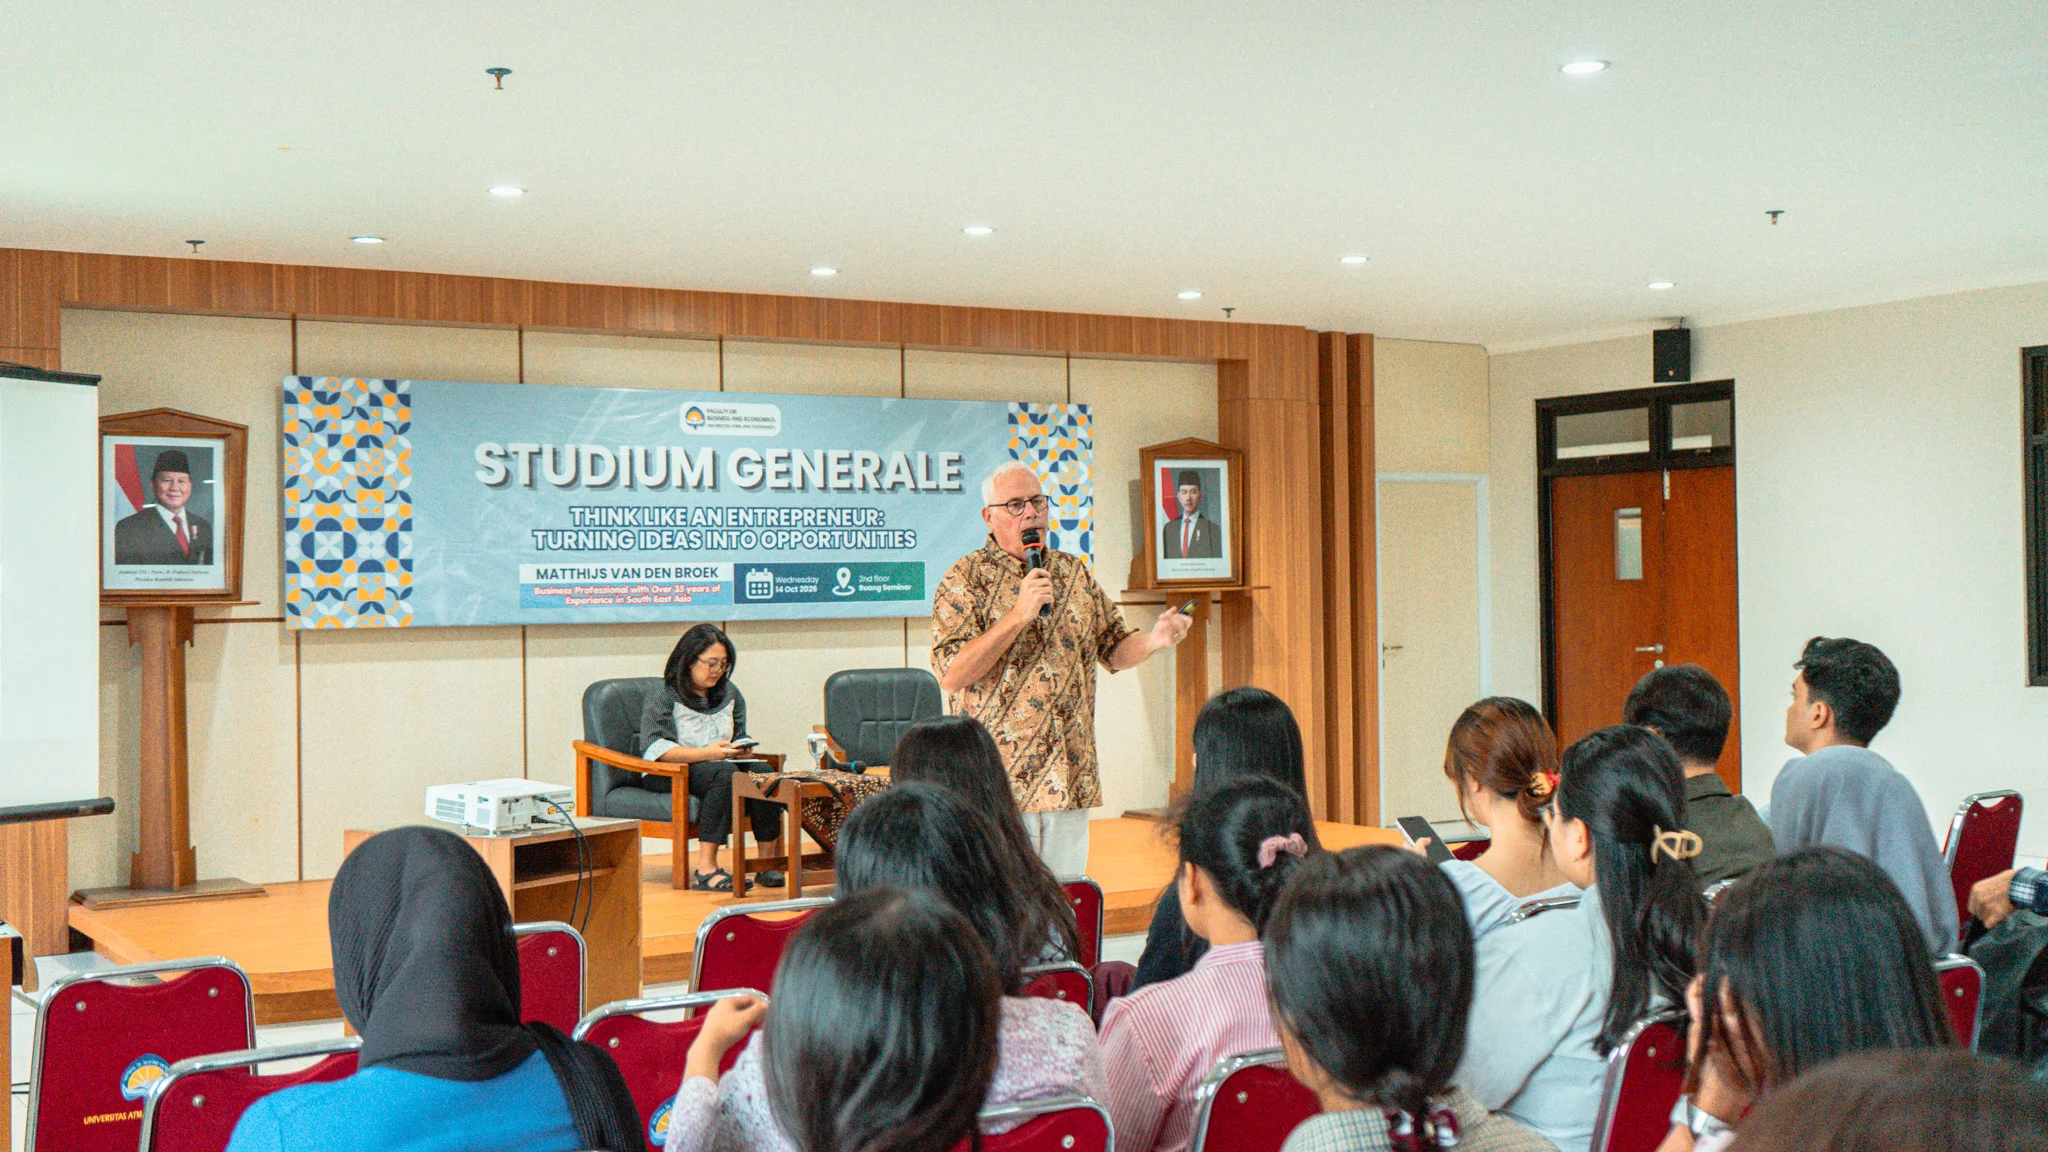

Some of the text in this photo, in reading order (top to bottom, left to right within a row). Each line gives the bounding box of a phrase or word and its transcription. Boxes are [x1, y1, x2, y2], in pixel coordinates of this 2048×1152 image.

[474, 442, 964, 492] STUDIUM GENERALE
[569, 506, 885, 527] THINK LIKE AN ENTREPRENEUR:
[532, 529, 917, 550] TURNING IDEAS INTO OPPORTUNITIES
[536, 567, 719, 580] MATTHIJS VAN DEN BROEK
[858, 575, 890, 583] 2nd floor
[775, 576, 820, 585] Wednesday
[533, 585, 573, 595] Business
[574, 585, 629, 595] Professional
[630, 584, 649, 594] with
[652, 584, 672, 594] Over
[686, 586, 711, 595] years
[711, 583, 721, 593] of
[784, 585, 798, 593] Oct
[858, 583, 912, 593] Ruang Seminar
[565, 594, 692, 606] Experience in South East Asia
[83, 1110, 143, 1125] UNIVERSITAS ATM
